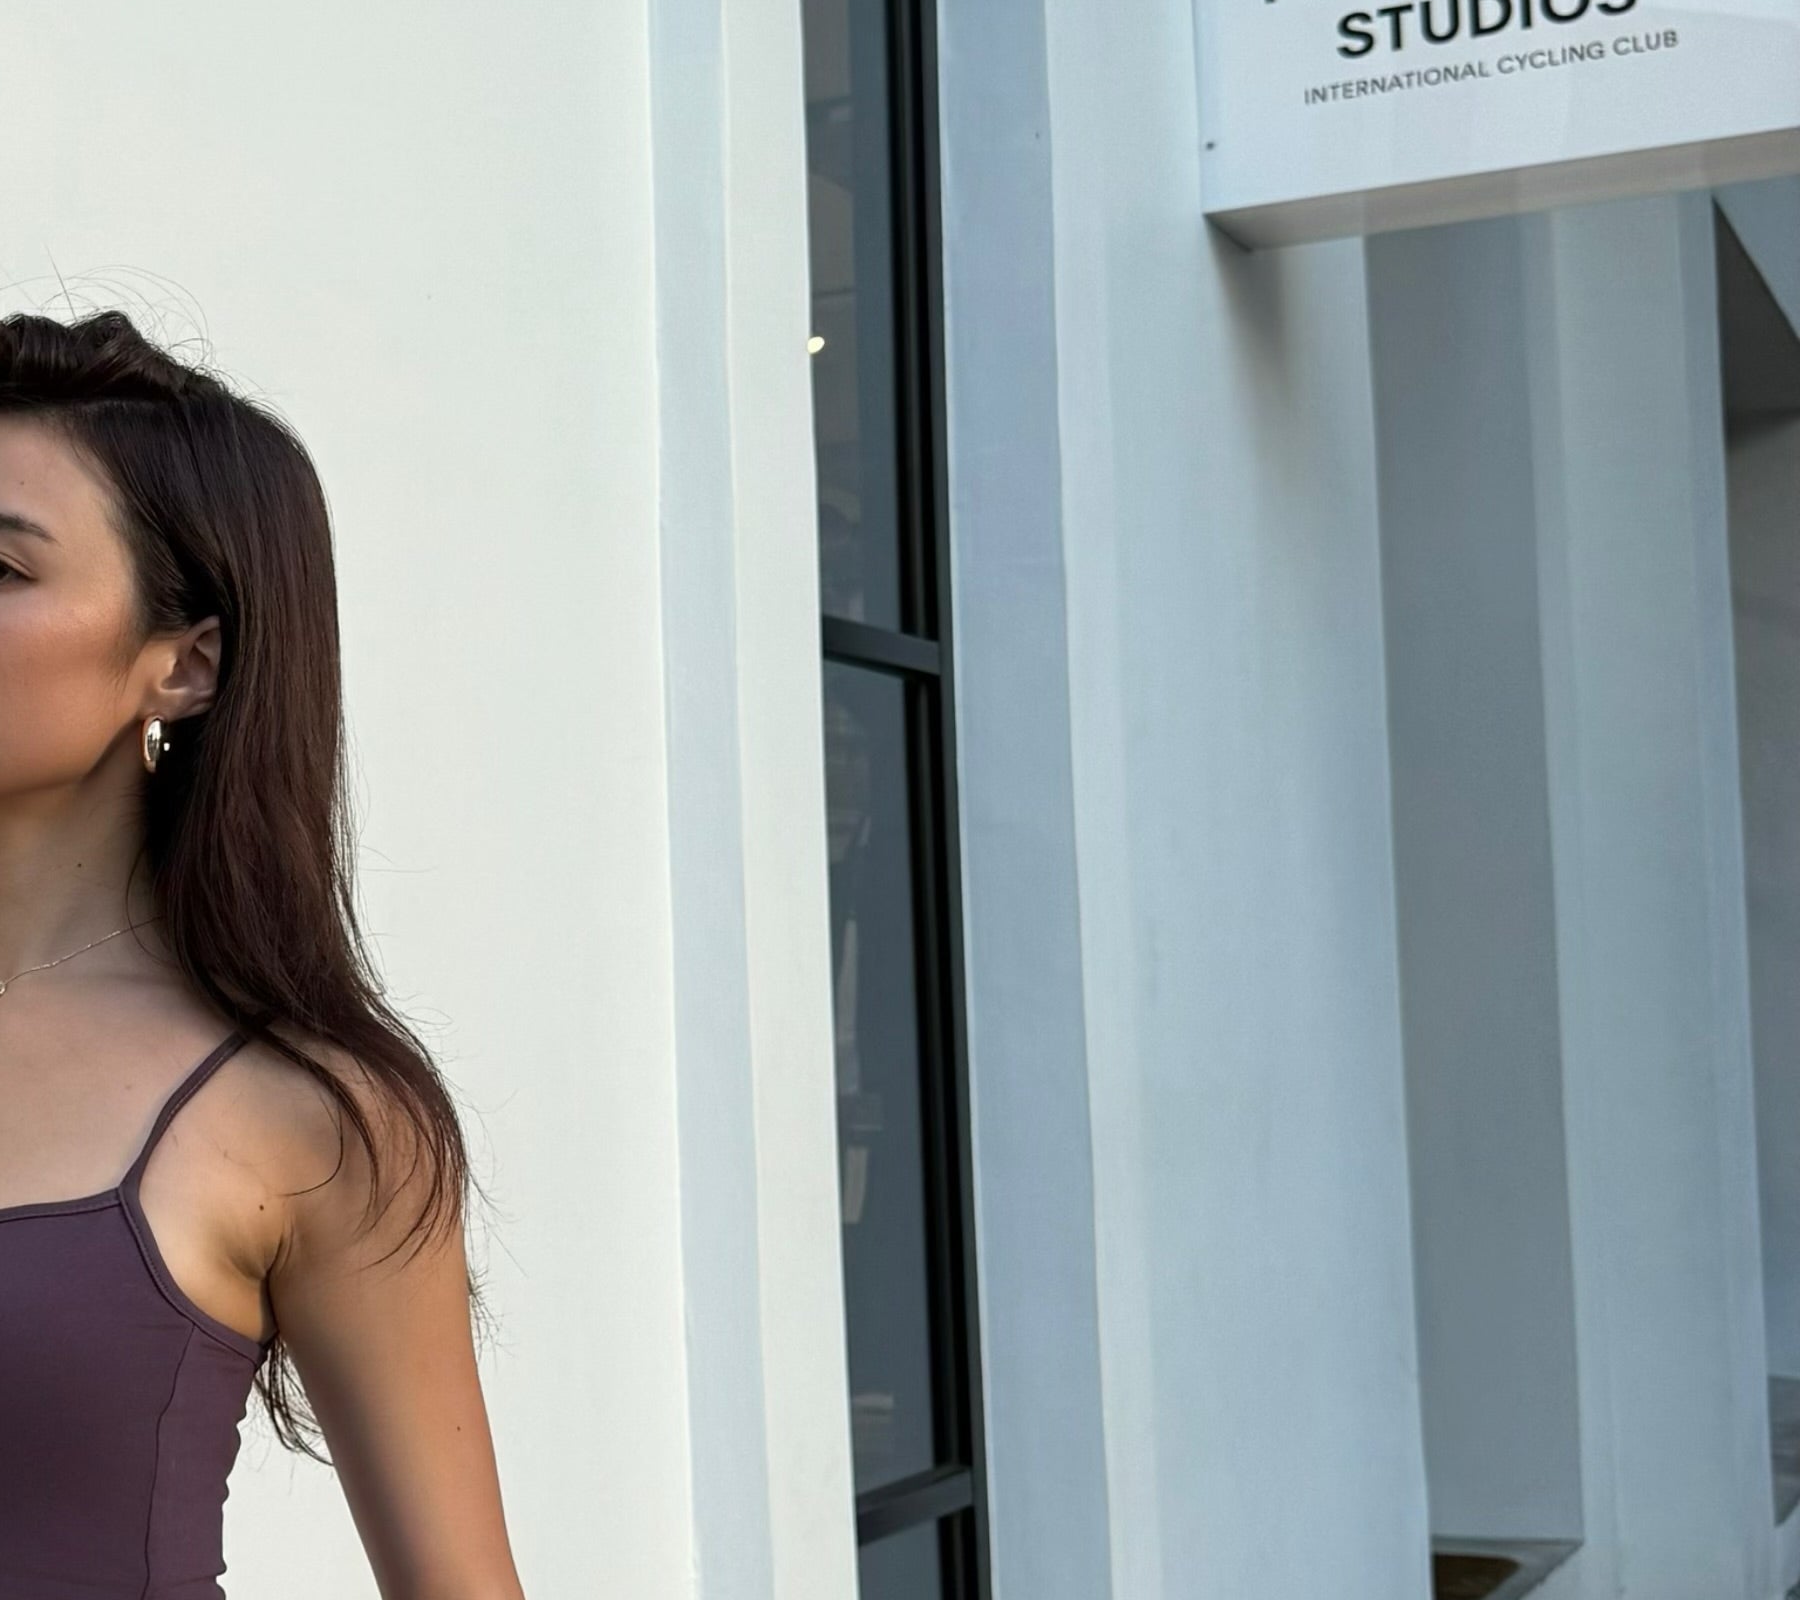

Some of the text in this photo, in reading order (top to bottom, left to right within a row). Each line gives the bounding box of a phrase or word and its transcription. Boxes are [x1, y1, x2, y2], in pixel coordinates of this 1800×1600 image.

[1304, 29, 1680, 105] INTERNATIONAL CYCLING CLUB
